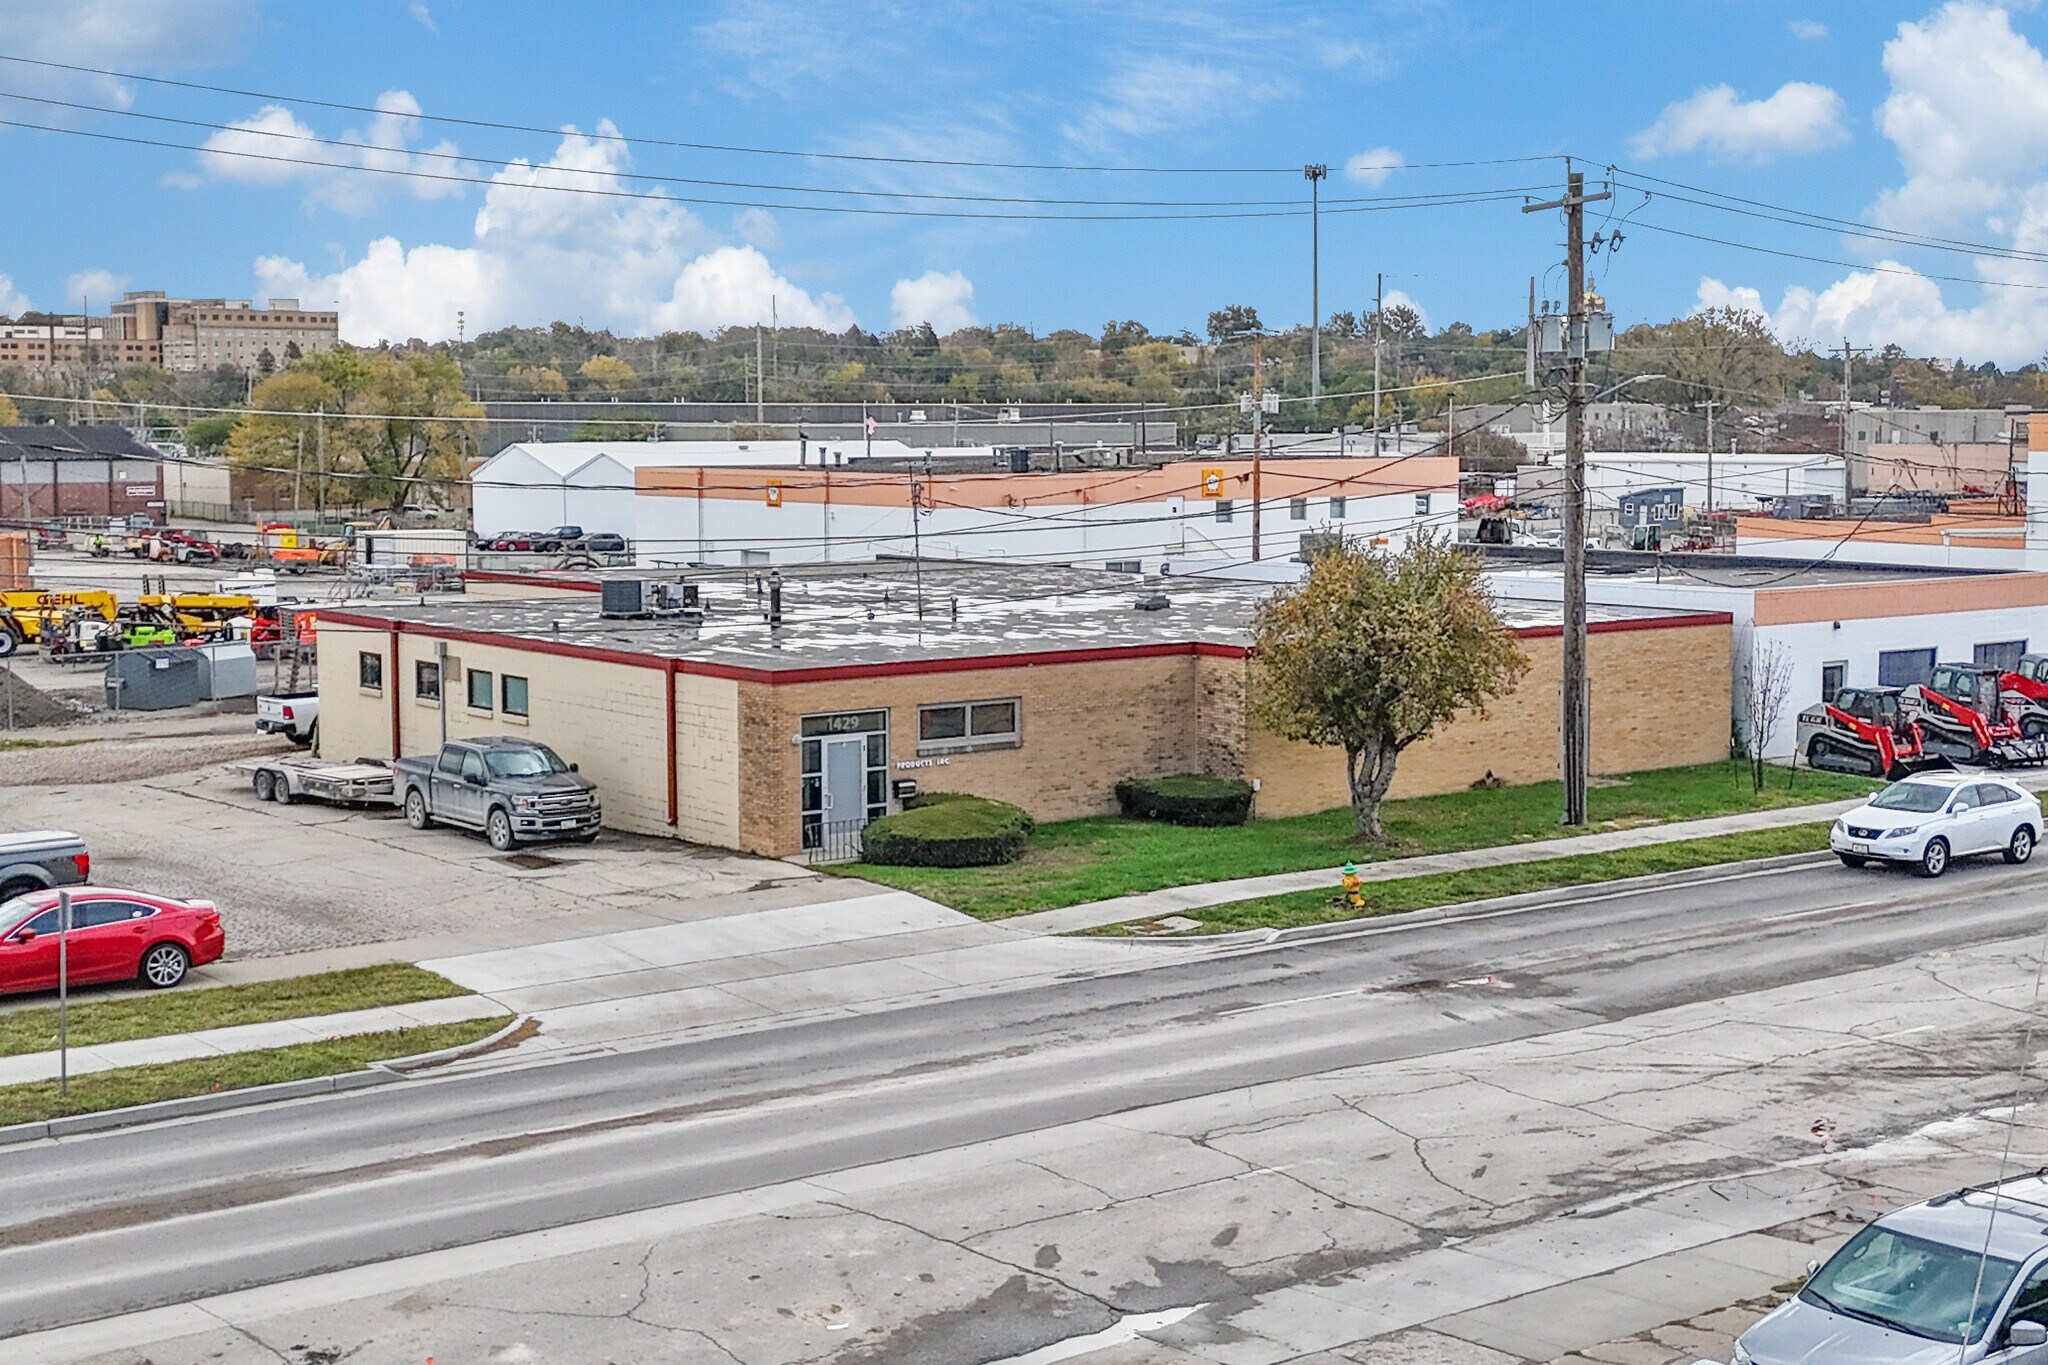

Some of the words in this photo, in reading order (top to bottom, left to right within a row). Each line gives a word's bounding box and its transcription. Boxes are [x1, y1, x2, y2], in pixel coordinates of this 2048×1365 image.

[36, 593, 85, 605] GEHL
[827, 715, 859, 731] 1429
[896, 759, 933, 769] PRODUCTS
